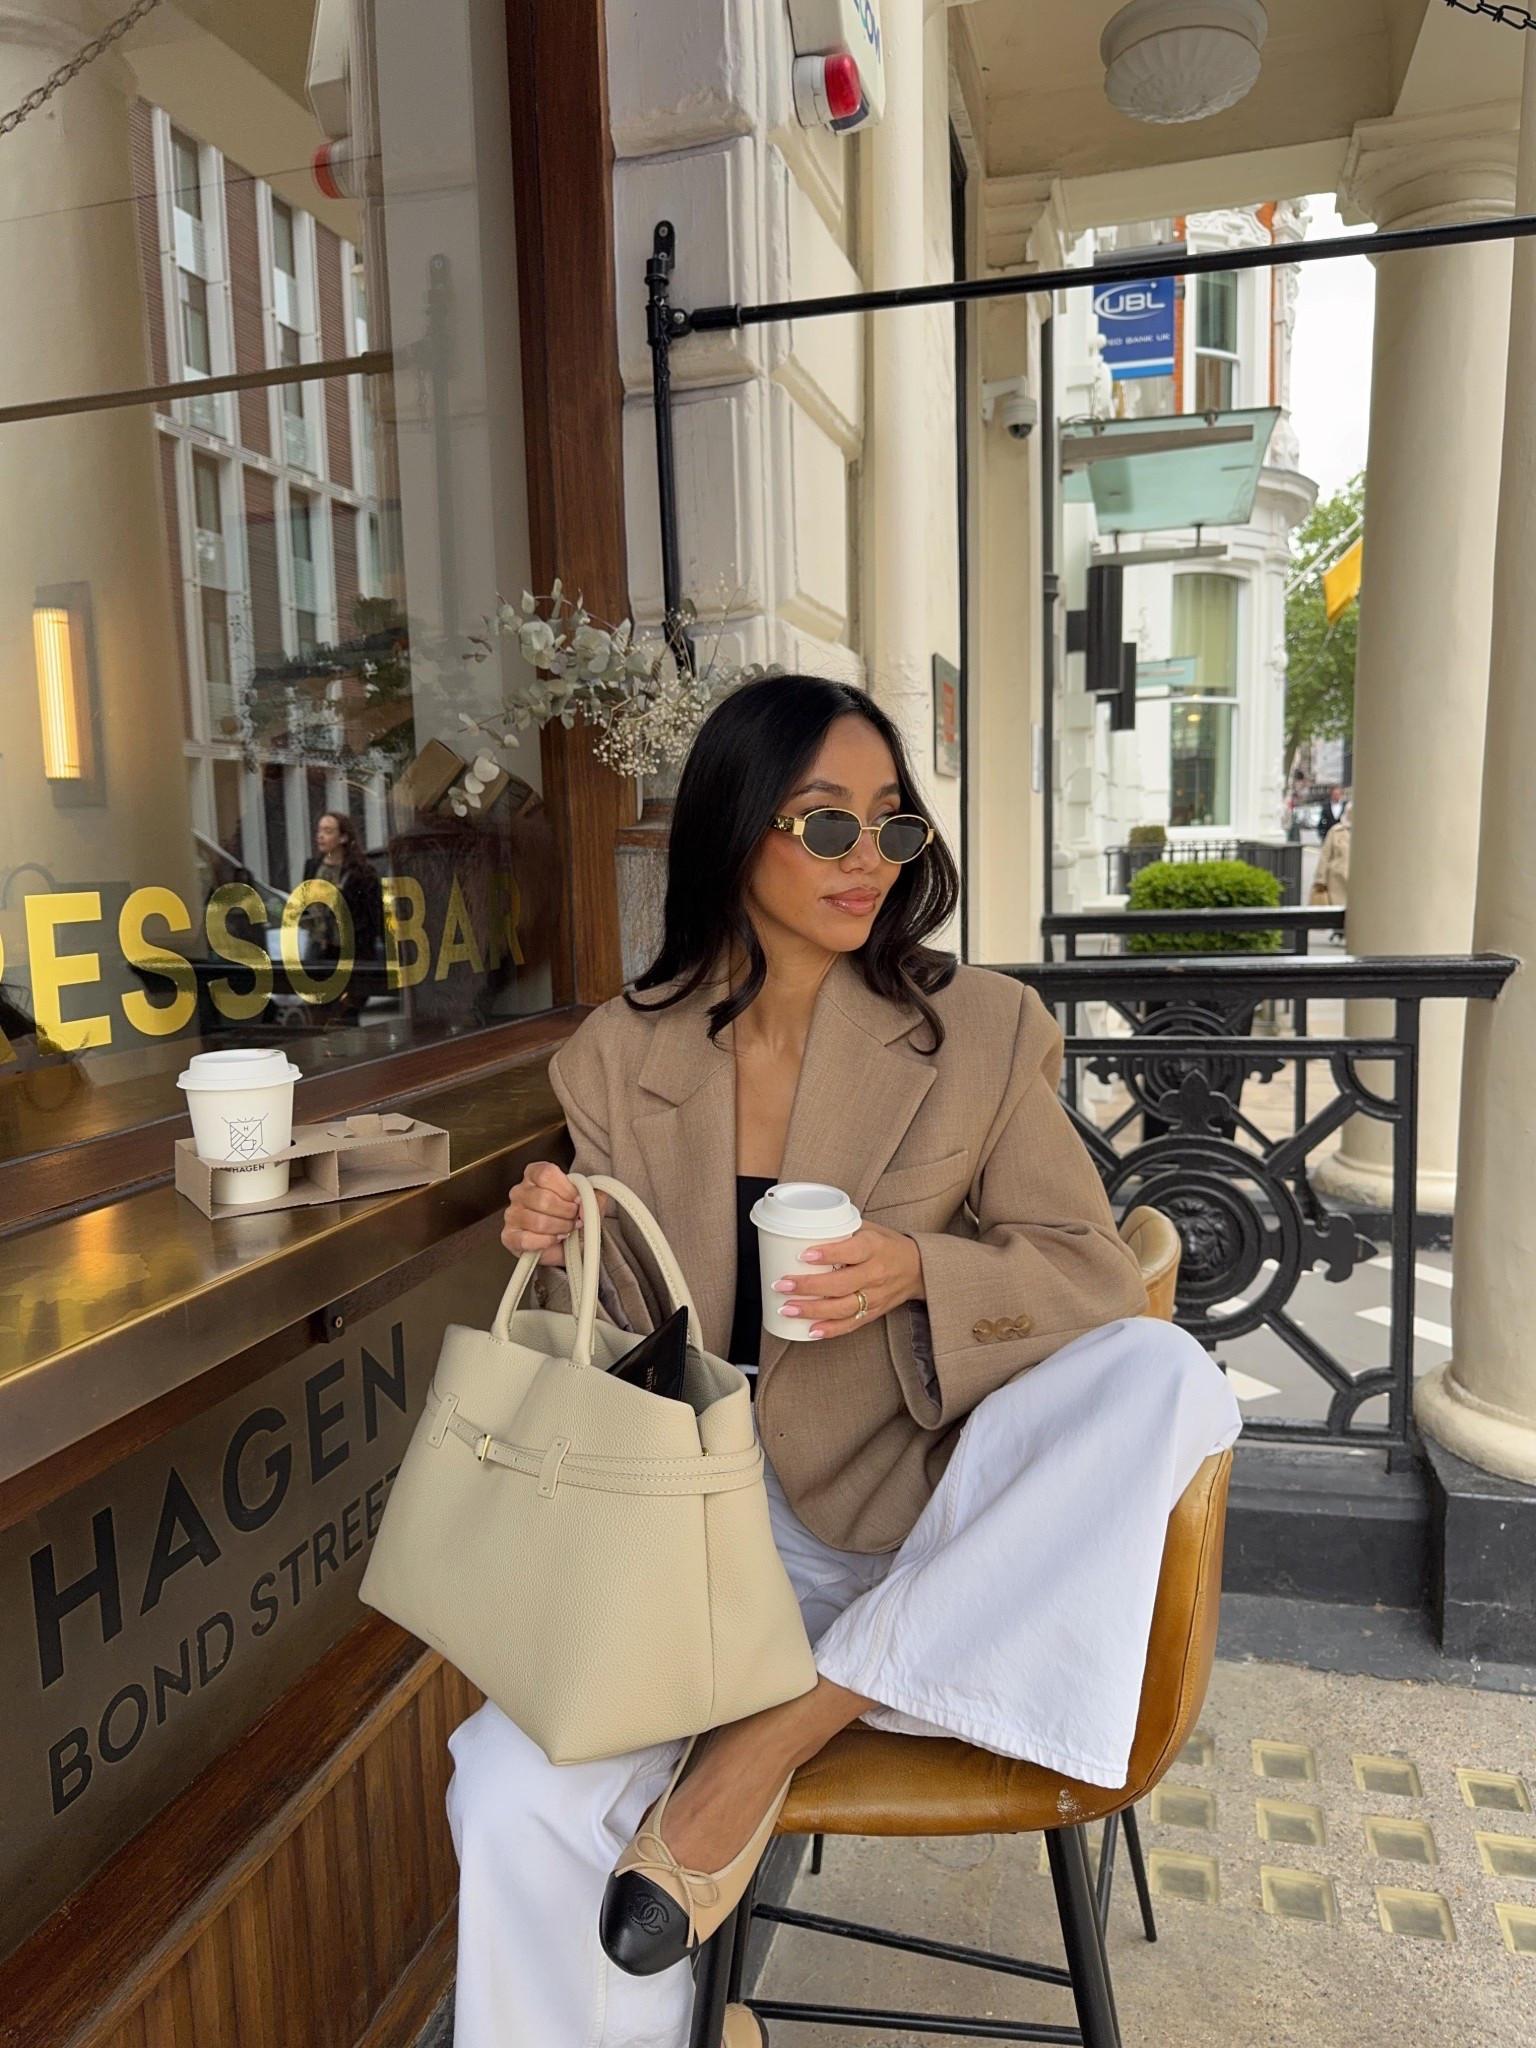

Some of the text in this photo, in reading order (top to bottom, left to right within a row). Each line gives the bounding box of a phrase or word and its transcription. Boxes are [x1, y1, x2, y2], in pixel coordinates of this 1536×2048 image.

[1103, 291, 1166, 314] UBL
[1125, 333, 1154, 345] BANK
[1155, 331, 1172, 342] UK
[0, 872, 525, 1065] ESSO BAR
[232, 1162, 265, 1174] HAGEN
[29, 1321, 407, 1690] HAGEN
[48, 1610, 235, 1816] BOND
